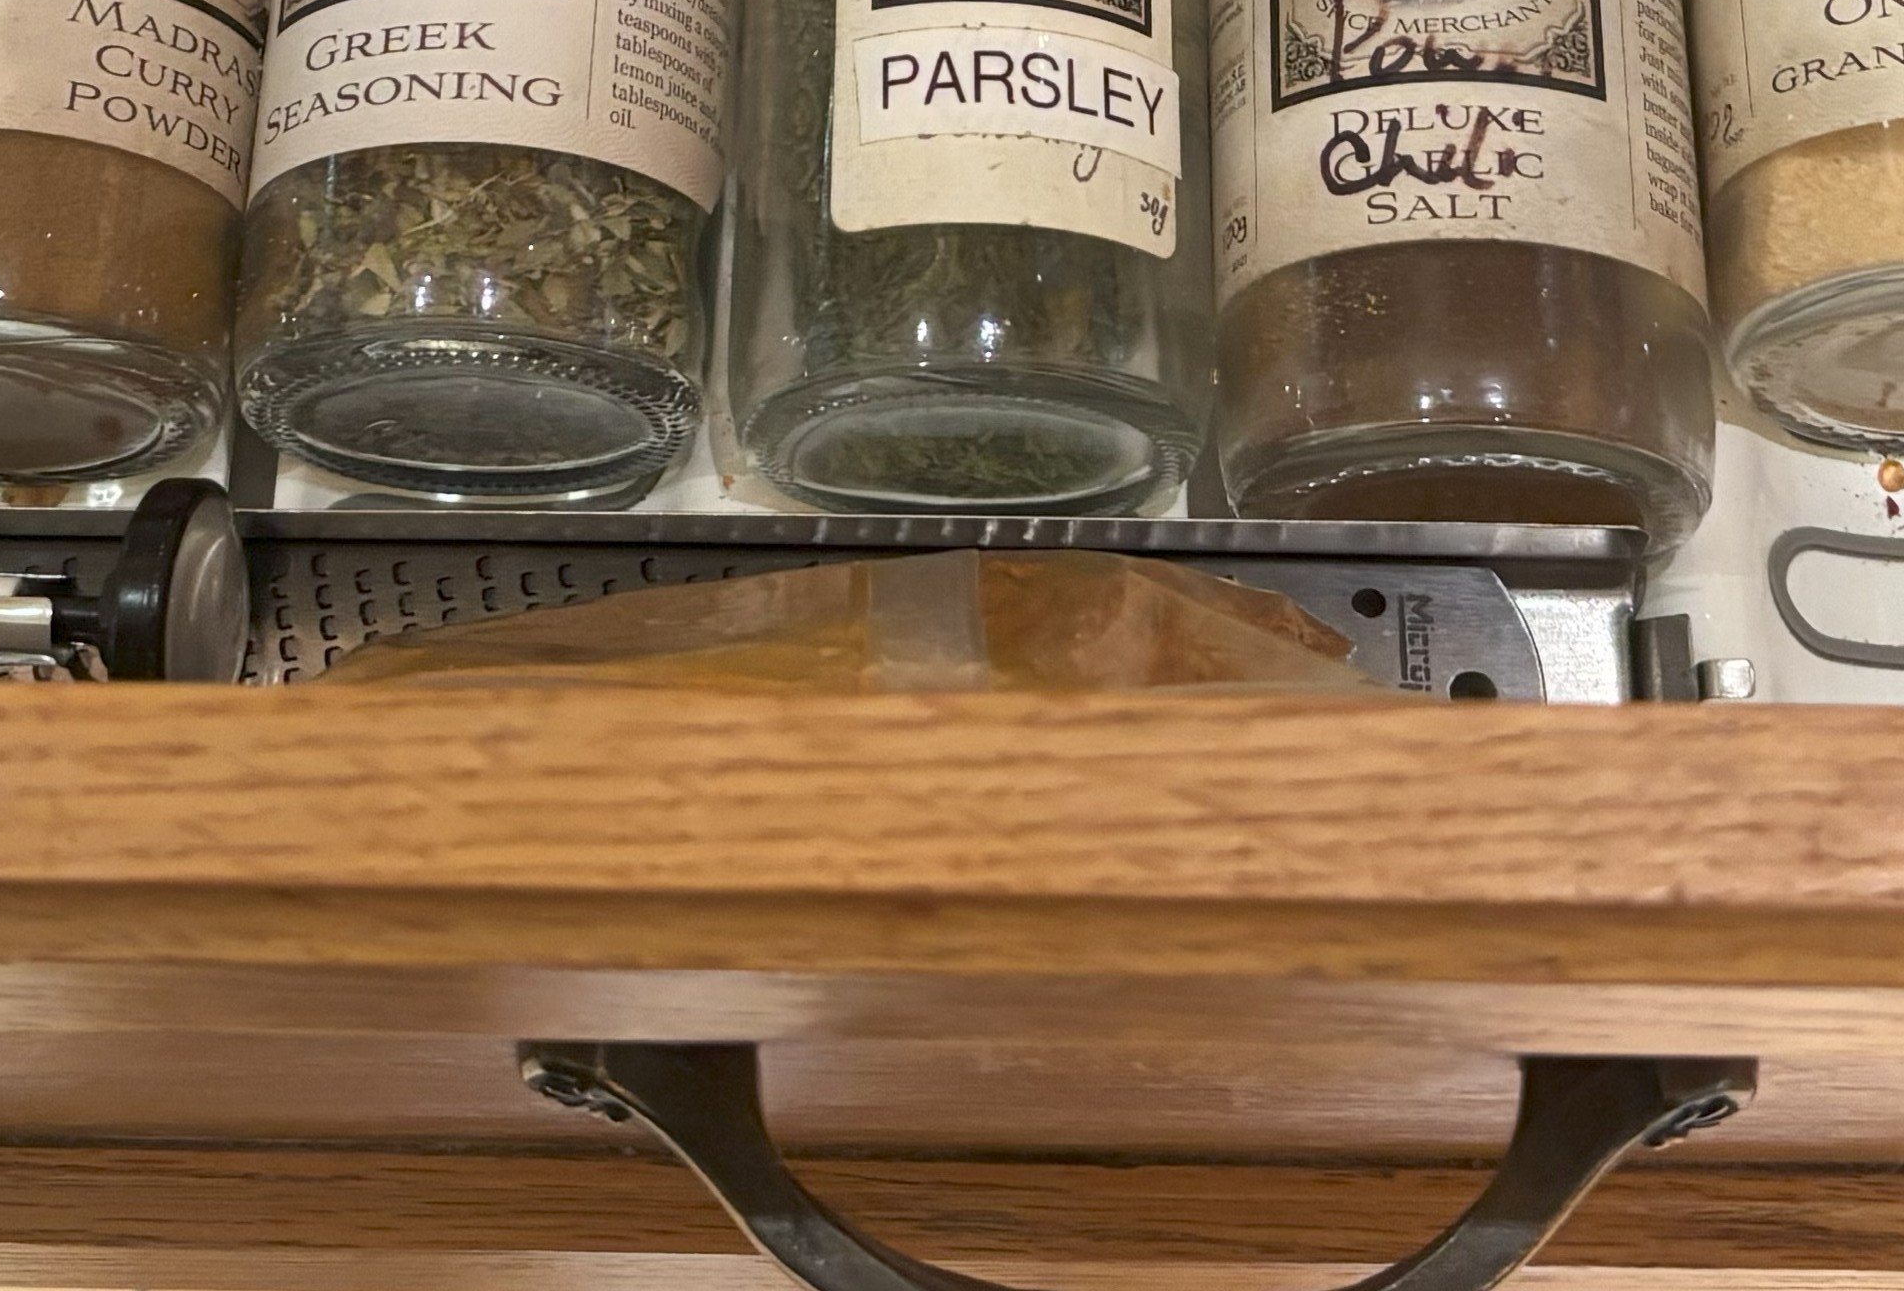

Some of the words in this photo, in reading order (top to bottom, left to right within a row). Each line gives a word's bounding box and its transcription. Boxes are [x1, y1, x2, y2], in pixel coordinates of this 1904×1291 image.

[95, 45, 240, 127] CURRY
[305, 22, 498, 73] GREEK
[64, 80, 245, 184] POWDER
[264, 71, 564, 147] SEASONING
[881, 50, 1164, 136] PARSLEY
[1367, 192, 1514, 225] SALT
